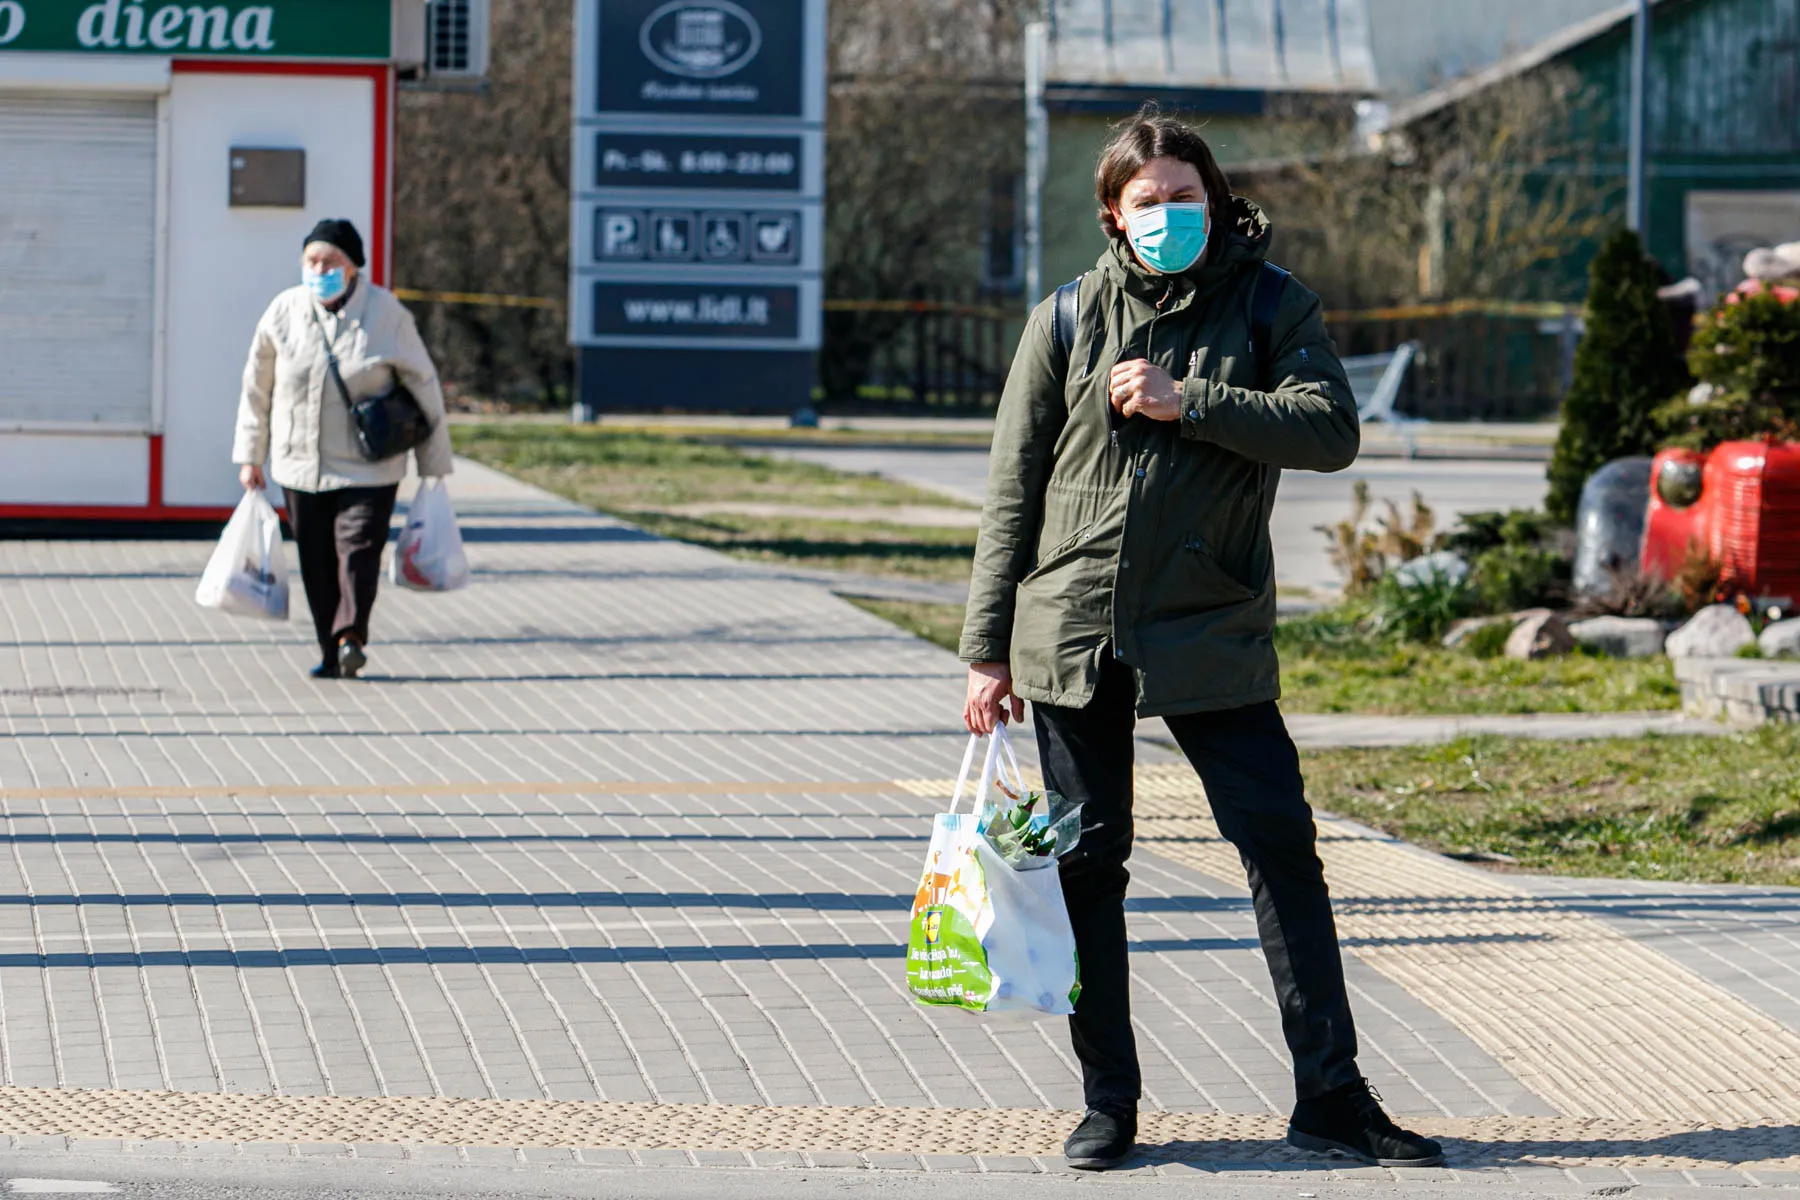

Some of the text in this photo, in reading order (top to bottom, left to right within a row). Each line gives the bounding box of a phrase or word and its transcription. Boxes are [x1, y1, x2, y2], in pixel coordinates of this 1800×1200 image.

[77, 0, 275, 50] diena
[604, 214, 637, 256] P
[624, 295, 768, 325] www.lidl.lt
